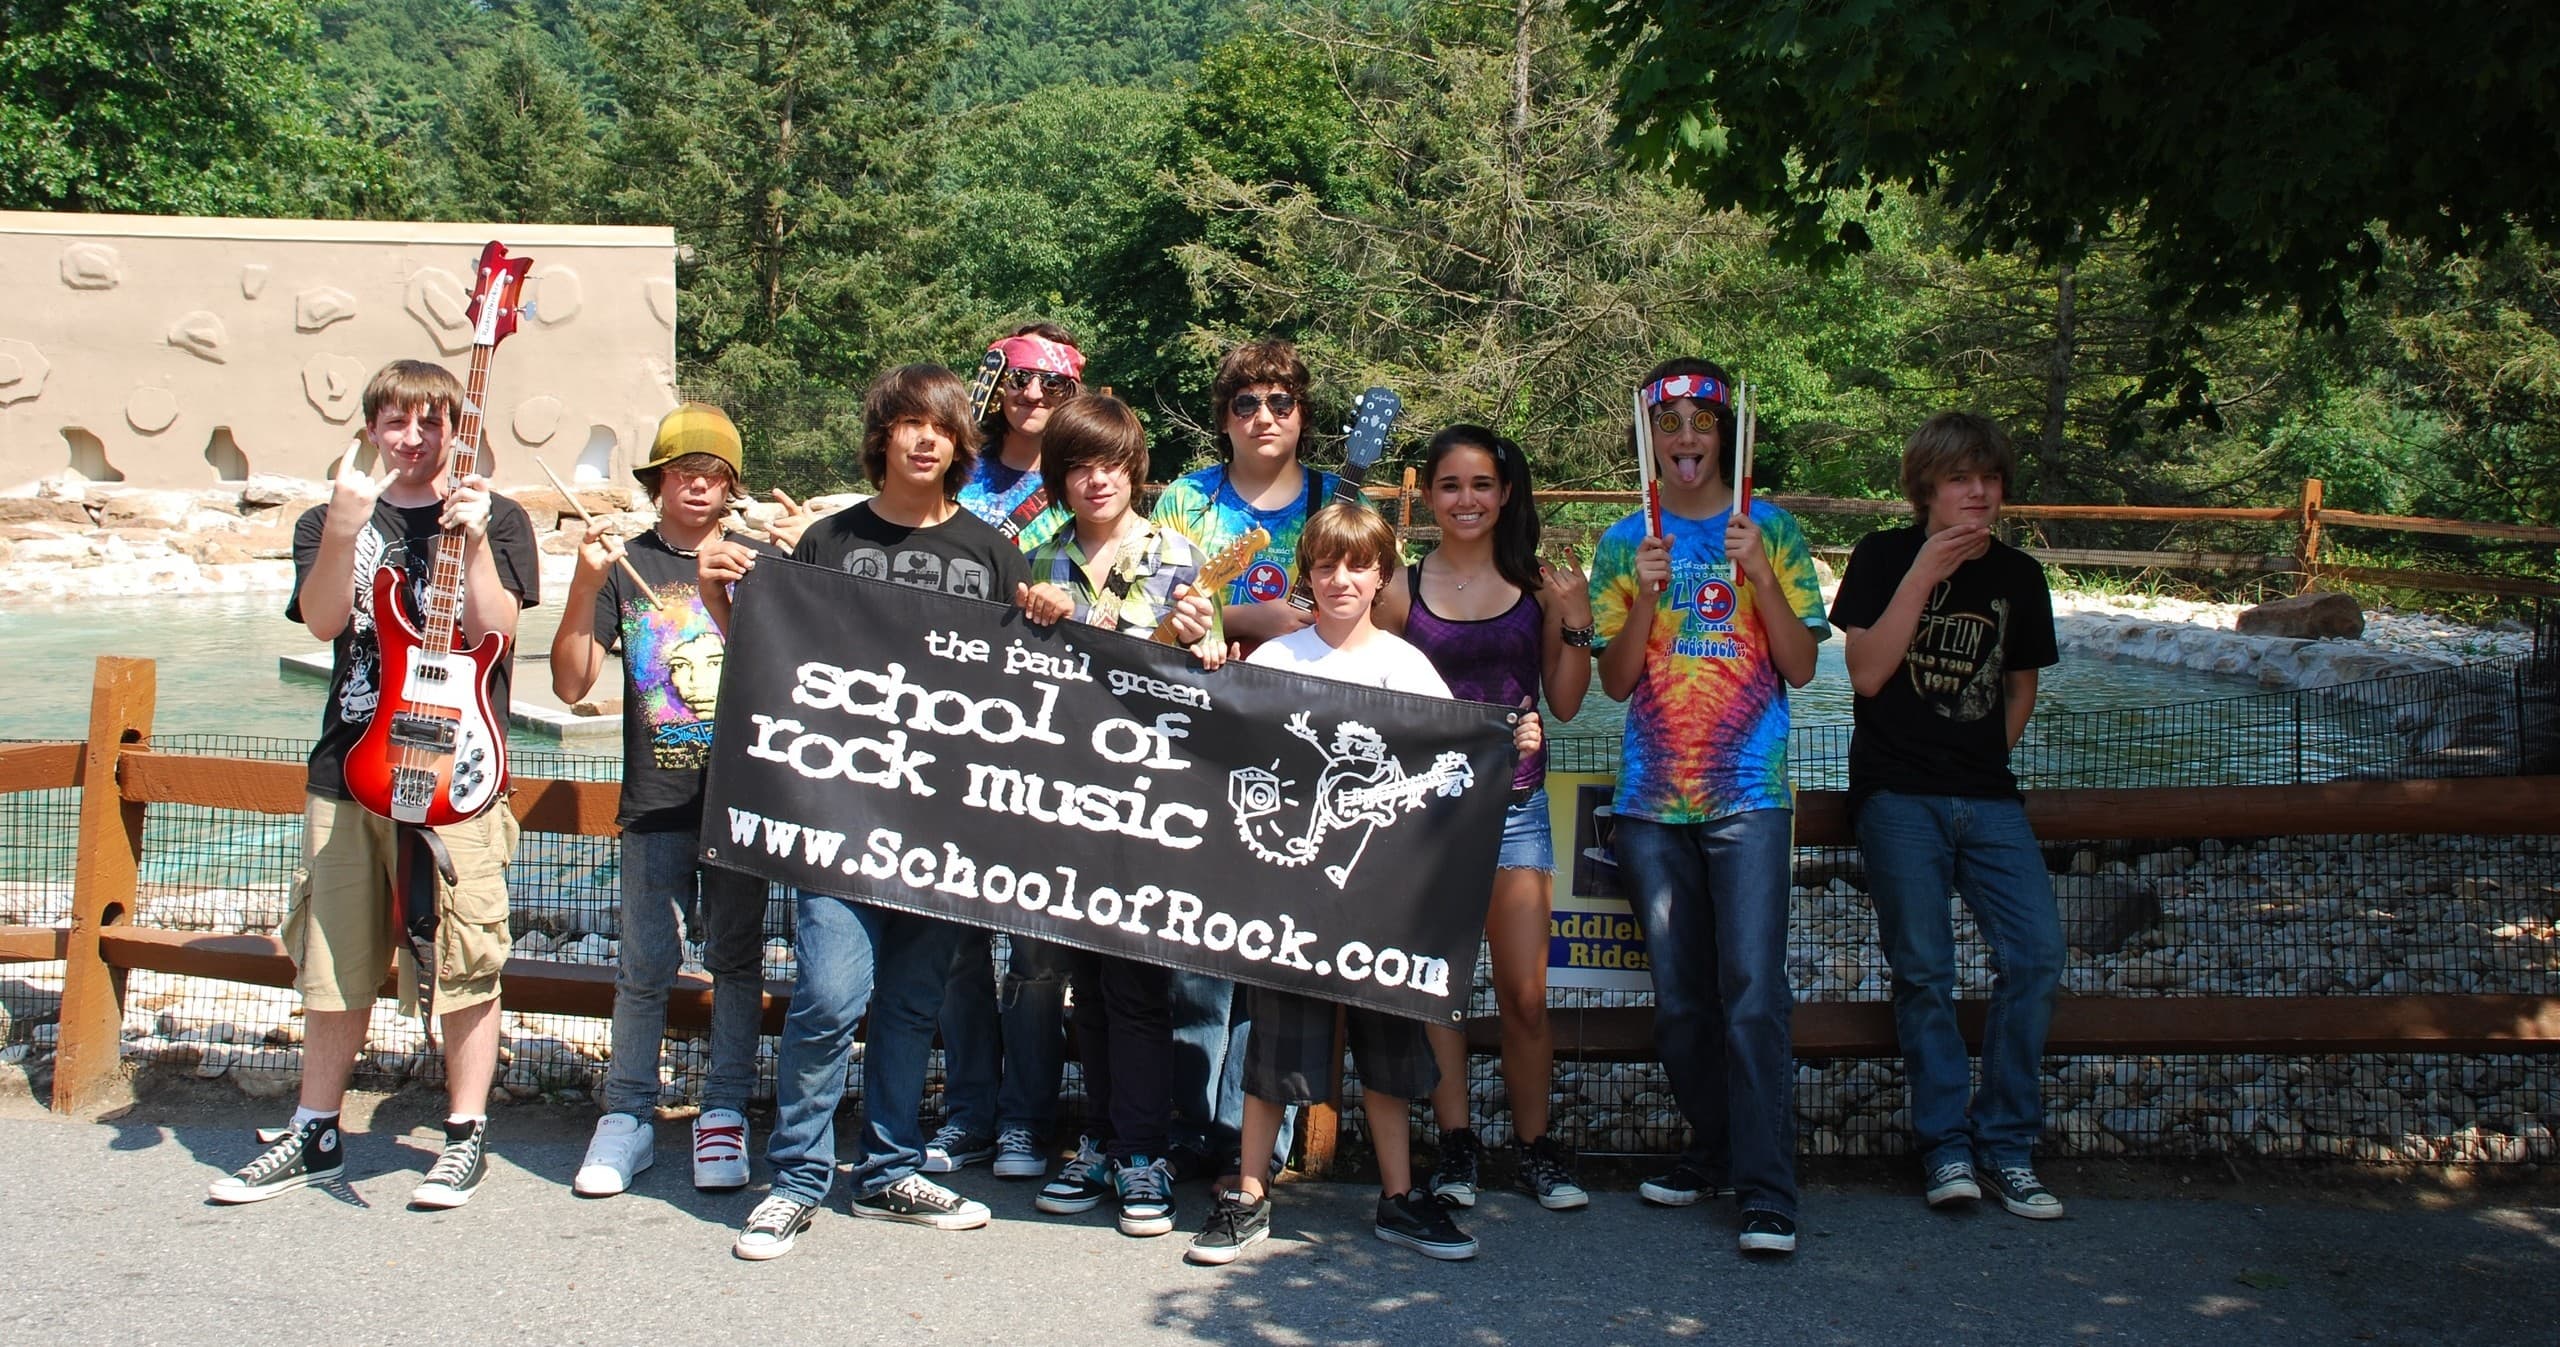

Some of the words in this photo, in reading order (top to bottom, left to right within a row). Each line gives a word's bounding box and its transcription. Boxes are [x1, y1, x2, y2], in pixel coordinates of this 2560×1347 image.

[1696, 623, 1735, 632] YEARS
[1939, 657, 1974, 673] TOUR
[925, 629, 989, 664] the
[1003, 638, 1094, 683] paul
[1107, 669, 1212, 712] green
[792, 661, 1066, 745] school
[1091, 711, 1193, 771] of
[746, 713, 936, 798] rock
[964, 762, 1209, 850] music
[726, 806, 1450, 997] www.SchoolofRock.com
[1550, 914, 1644, 941] addle
